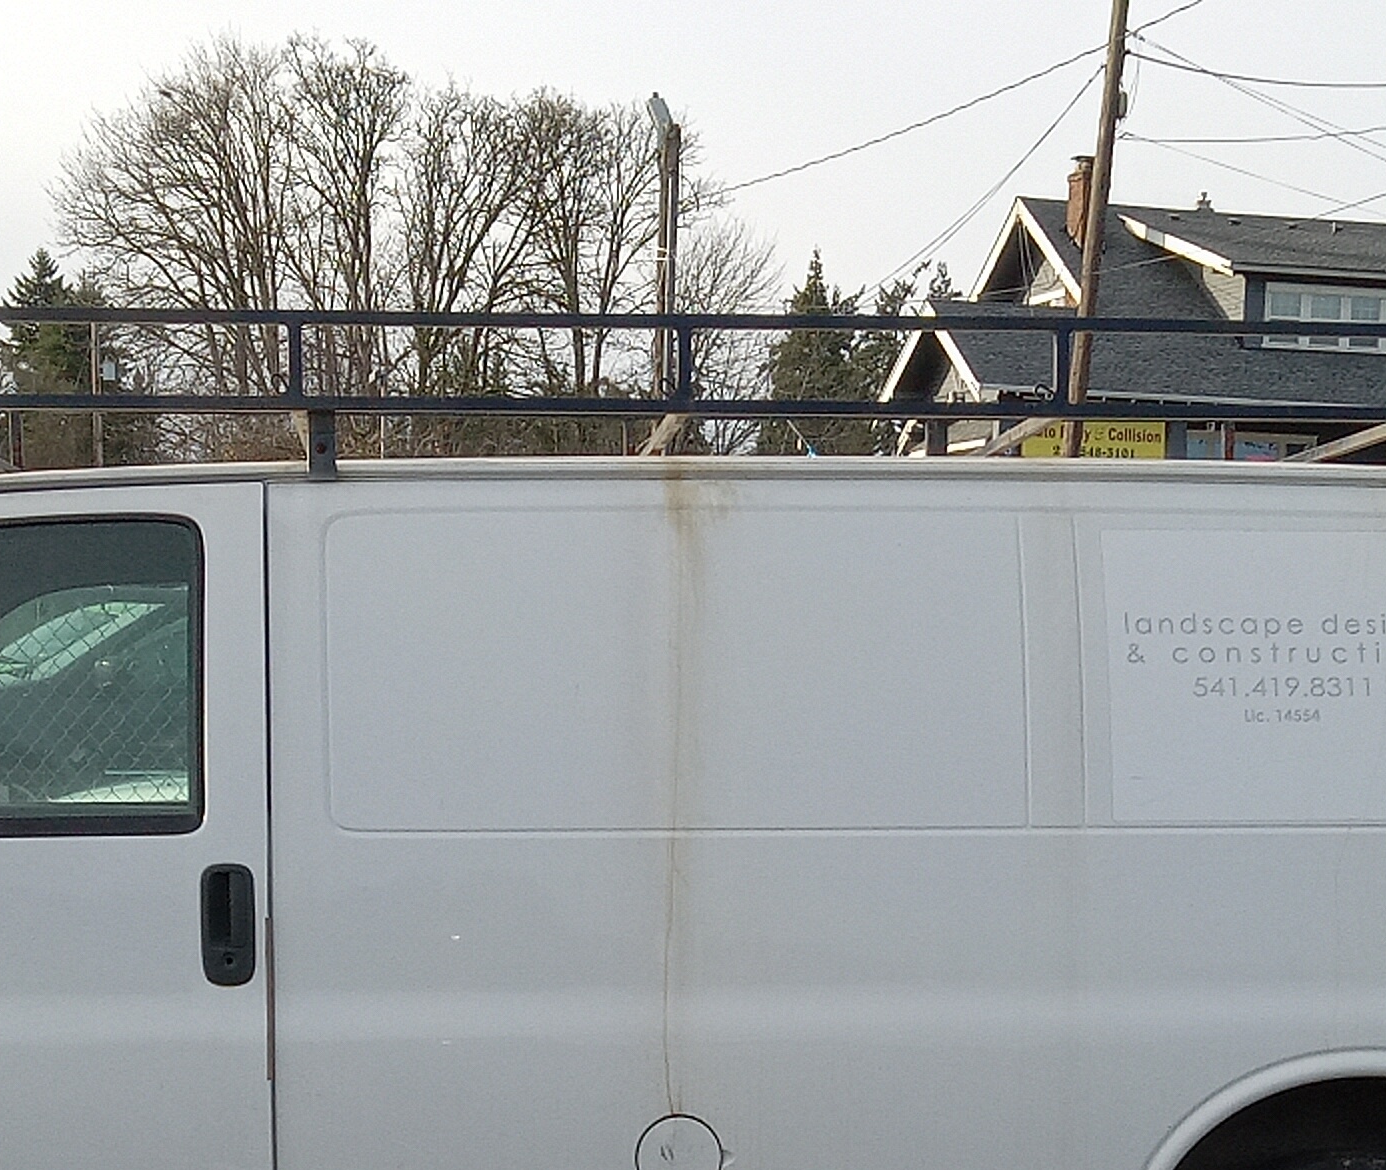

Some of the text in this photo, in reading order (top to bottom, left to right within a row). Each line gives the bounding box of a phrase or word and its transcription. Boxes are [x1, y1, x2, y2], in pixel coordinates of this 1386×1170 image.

[1108, 427, 1162, 443] Collision
[1123, 612, 1304, 638] landscape
[1126, 643, 1146, 664] &
[1193, 677, 1372, 697] 541.419.8311
